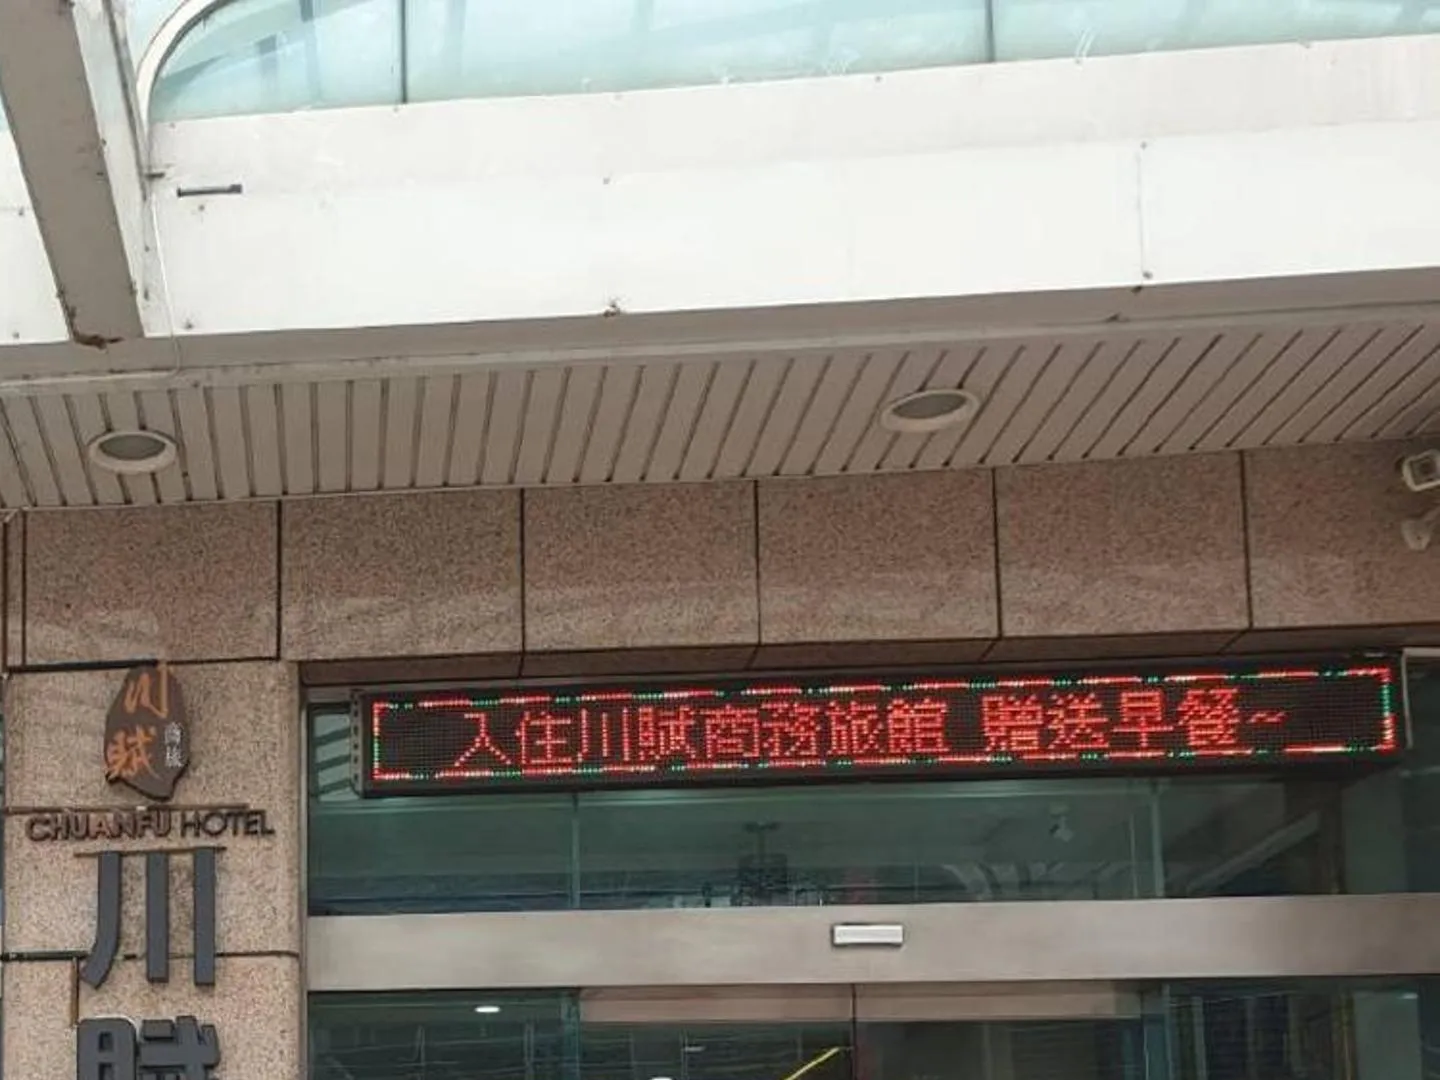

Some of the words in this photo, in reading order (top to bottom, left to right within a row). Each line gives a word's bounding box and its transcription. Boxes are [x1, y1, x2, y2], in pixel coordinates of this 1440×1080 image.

[454, 696, 950, 767] 入住川賦商務旅館
[25, 810, 172, 843] CHUANFU
[180, 808, 276, 838] HOTEL
